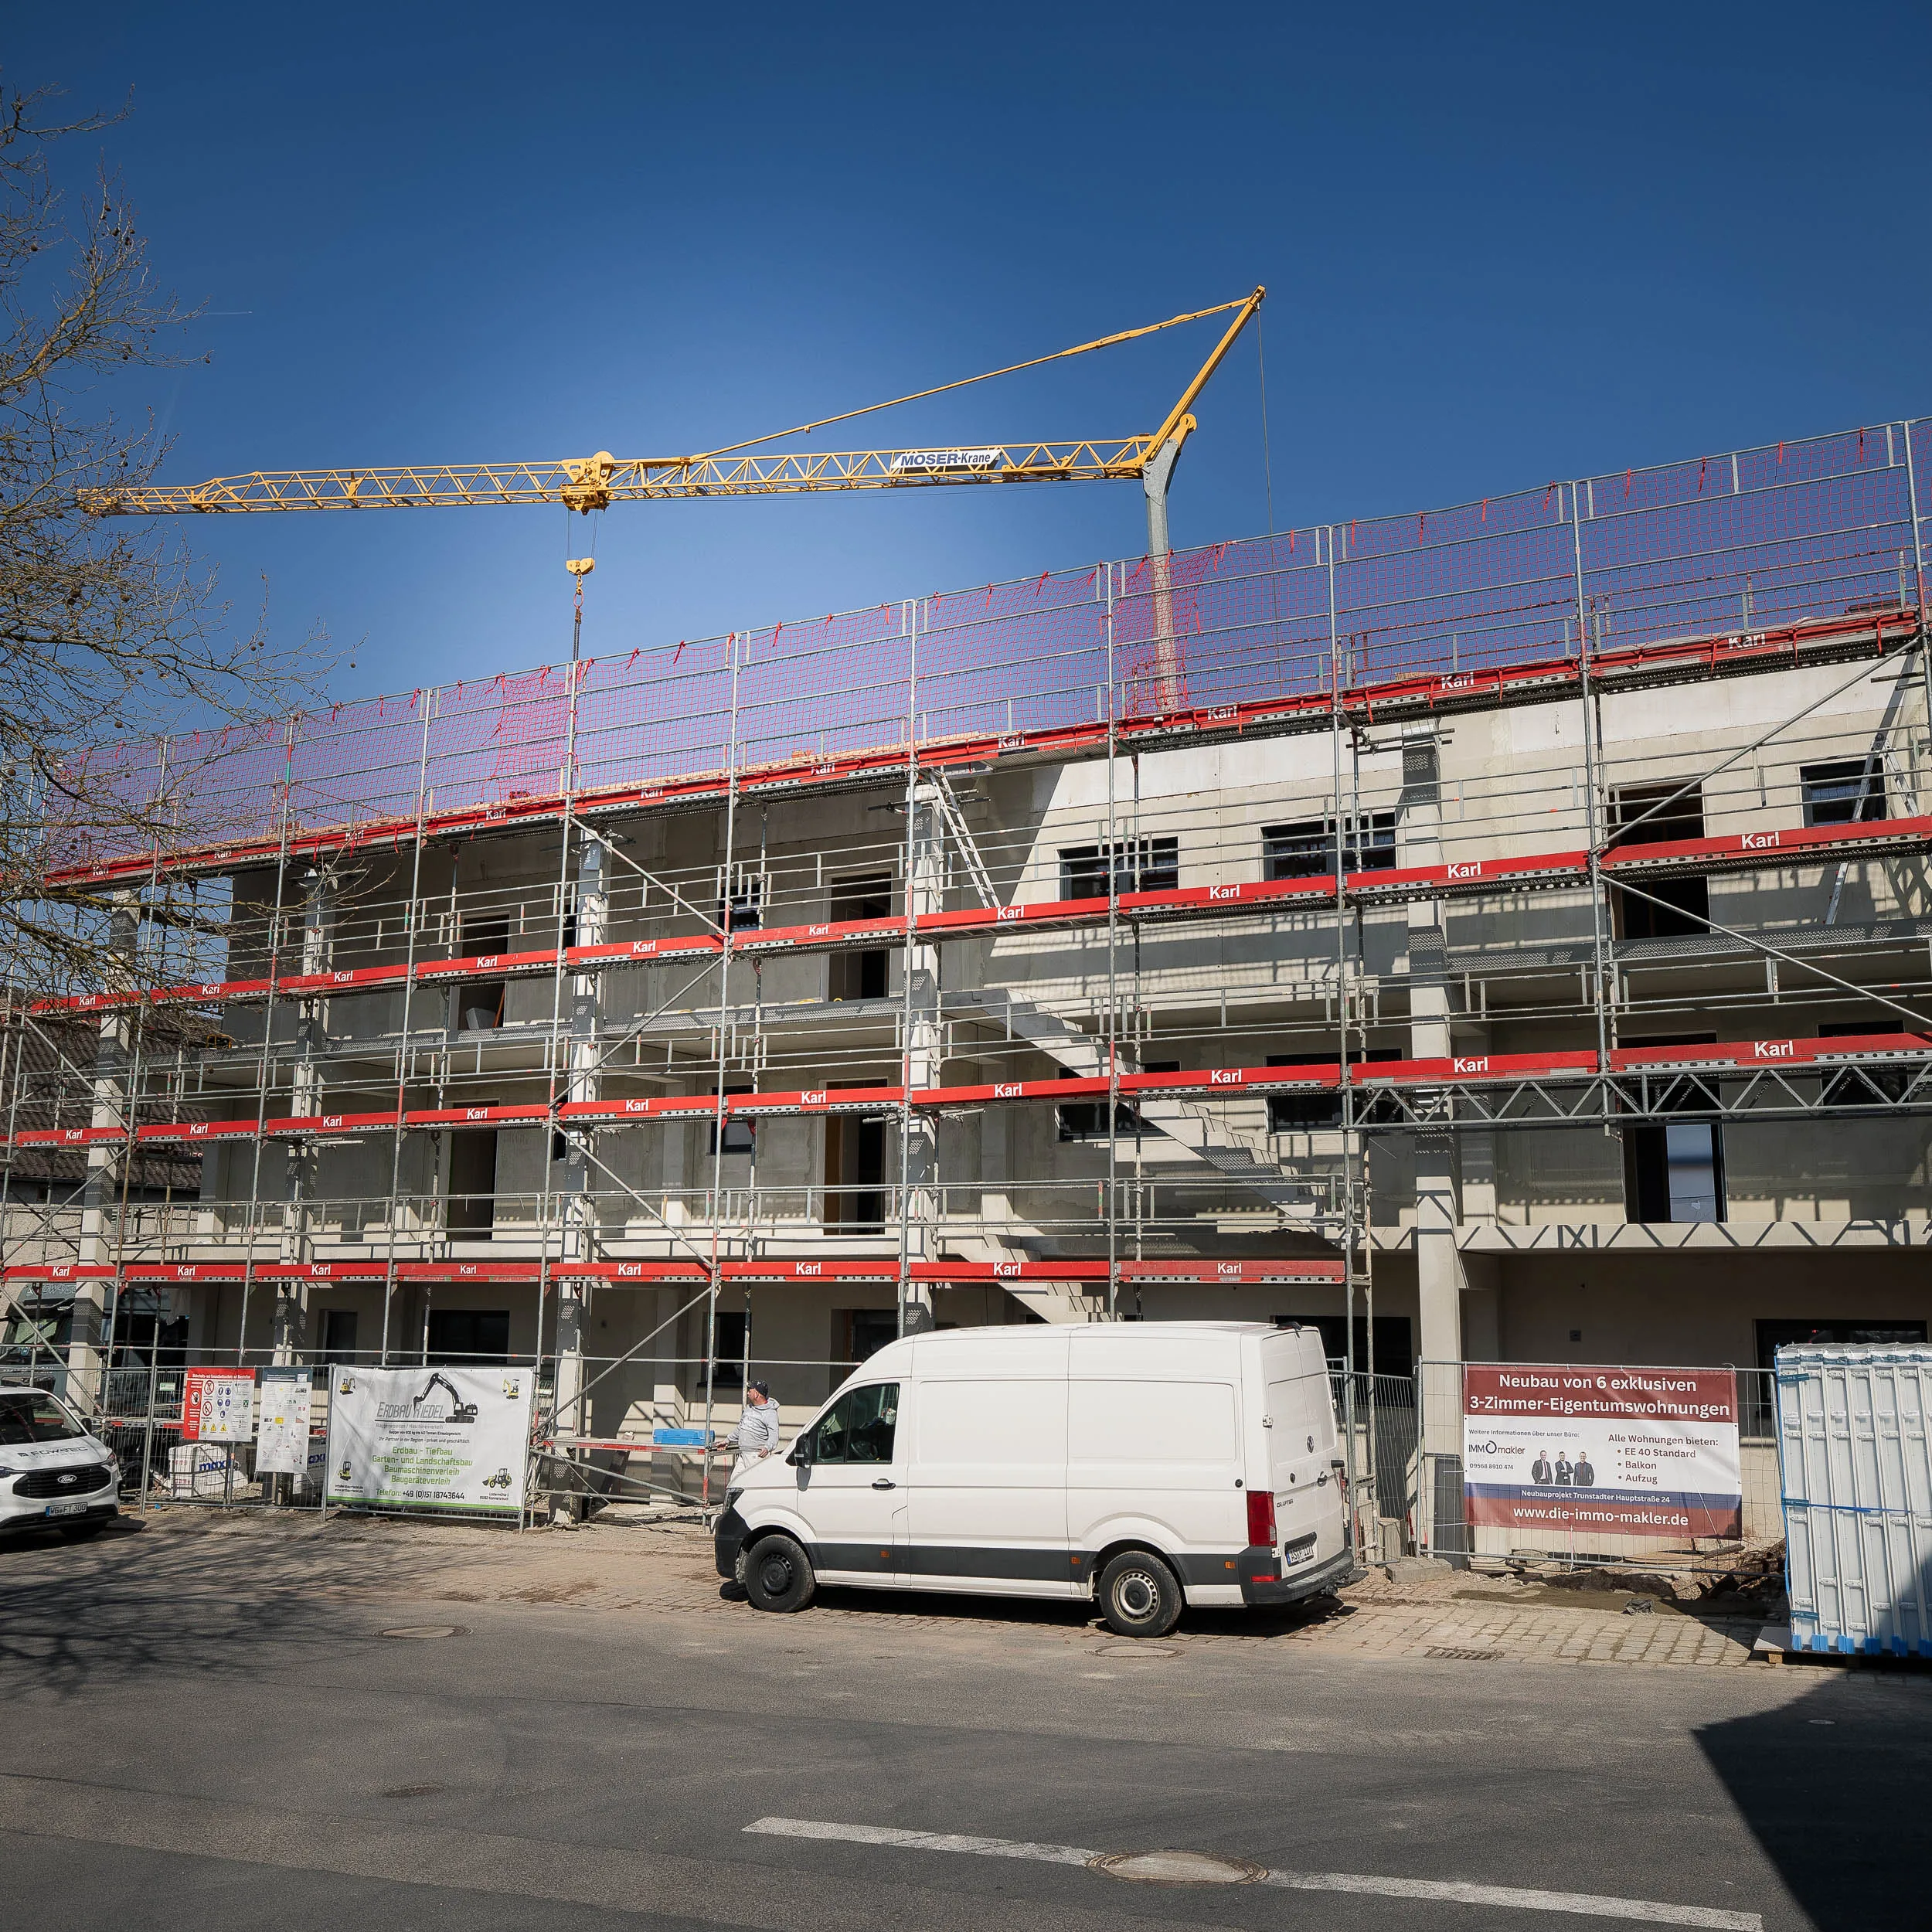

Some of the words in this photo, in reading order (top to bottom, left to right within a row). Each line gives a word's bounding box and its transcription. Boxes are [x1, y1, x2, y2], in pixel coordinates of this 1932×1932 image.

[900, 453, 991, 466] MOSER-Krane
[1728, 632, 1767, 649] Karl
[1441, 675, 1475, 689] Karl
[1207, 704, 1239, 719] Karl
[998, 734, 1026, 749] Karl
[811, 762, 835, 775] Karl
[641, 787, 663, 798] Karl
[485, 808, 506, 821] Karl
[1741, 831, 1780, 850] Karl
[1447, 862, 1481, 878] Karl
[1209, 884, 1240, 900] Karl
[996, 904, 1026, 920] Karl
[808, 923, 829, 937] Karl
[631, 940, 657, 954] Karl
[476, 954, 498, 968] Karl
[334, 970, 354, 983] Karl
[202, 982, 219, 994] Karl
[79, 995, 97, 1005] Karl
[1754, 1040, 1794, 1057] Karl
[1454, 1056, 1488, 1073] Karl
[1211, 1069, 1242, 1084] Karl
[994, 1082, 1022, 1098] Karl
[801, 1090, 826, 1104] Karl
[625, 1098, 651, 1113] Karl
[466, 1107, 488, 1120] Karl
[322, 1115, 342, 1128] Karl
[65, 1128, 83, 1140] Karl
[189, 1123, 209, 1134] Karl
[52, 1266, 70, 1277] Karl
[177, 1265, 196, 1277] Karl
[311, 1264, 332, 1276] Karl
[460, 1264, 477, 1274] Karl
[617, 1262, 642, 1276] Karl
[795, 1261, 822, 1275] Karl
[992, 1261, 1022, 1277] Karl
[1217, 1262, 1242, 1274] Karl
[1499, 1374, 1559, 1389] Neubau
[1563, 1379, 1592, 1389] von
[1596, 1376, 1607, 1389] 6
[1611, 1377, 1697, 1392] exklusiven
[1469, 1396, 1730, 1418] 3-Zimmer-Eigentumswohnungen
[1628, 1435, 1683, 1445] Wohnungen
[1685, 1437, 1719, 1446] bieten:
[1653, 1449, 1696, 1458] Standard
[372, 1455, 398, 1464] Garten-
[416, 1457, 473, 1466] Landschaftsbau
[1625, 1461, 1657, 1470] Balkon
[384, 1465, 461, 1476] Baumaschinenverleih
[391, 1475, 451, 1485] Baugeräteverleih
[1625, 1475, 1658, 1485] Aufzug
[376, 1488, 402, 1497] Telefon:
[1522, 1489, 1572, 1499] Neubauprojekt
[1573, 1492, 1614, 1501] Trunstadter
[1616, 1494, 1660, 1503] Hauptstraße
[73, 1503, 87, 1512] 300
[1513, 1507, 1689, 1526] www.die-immo-makler.de
